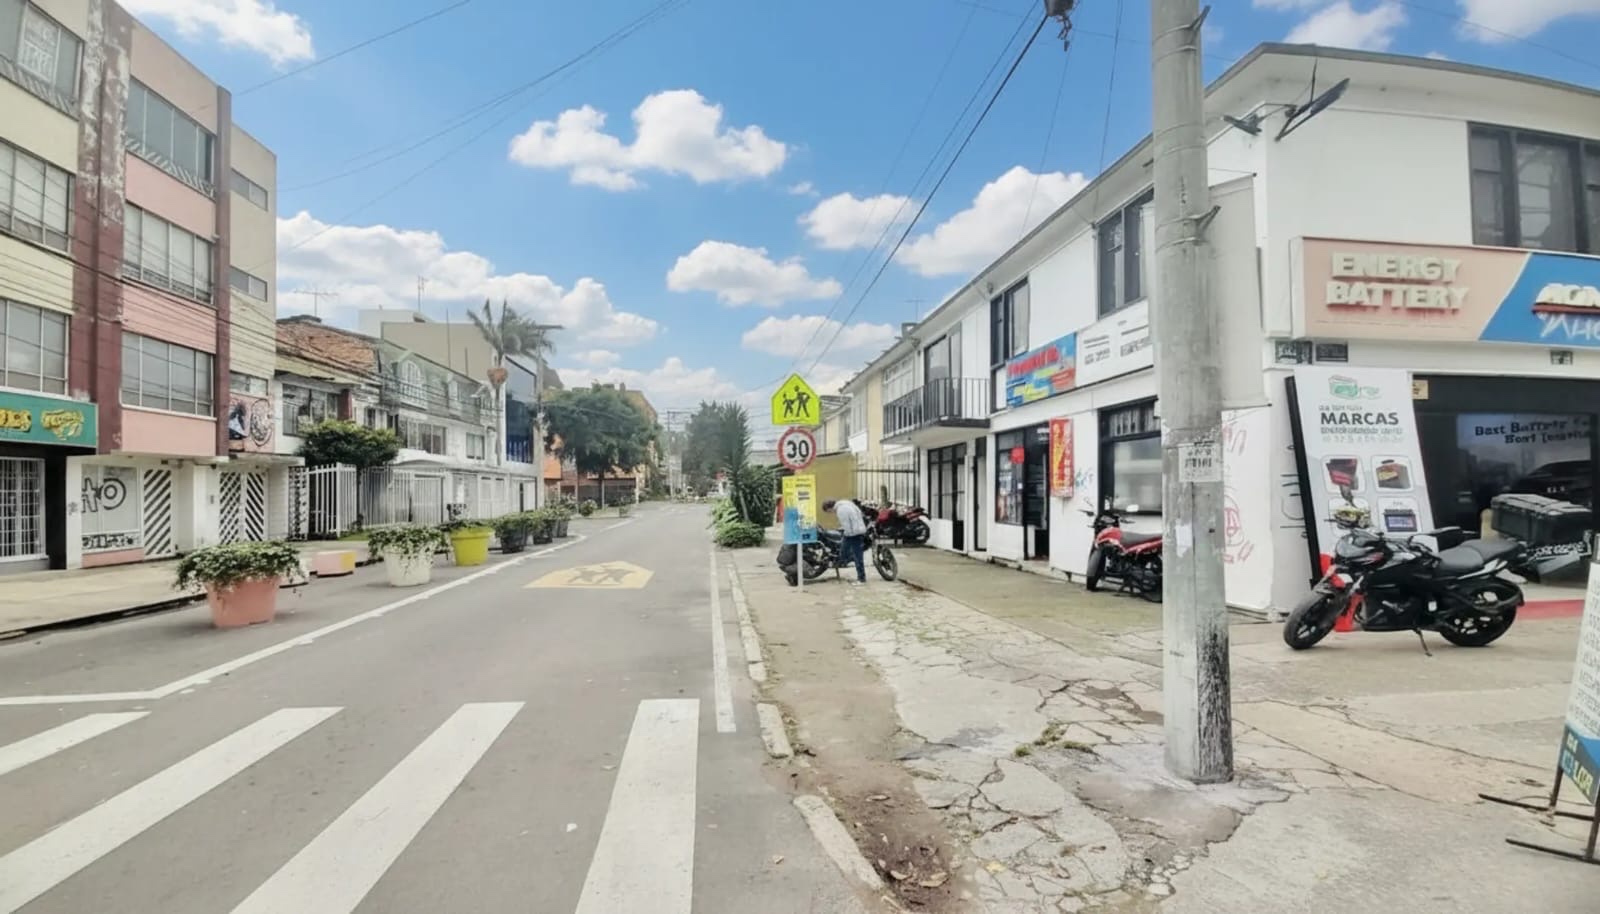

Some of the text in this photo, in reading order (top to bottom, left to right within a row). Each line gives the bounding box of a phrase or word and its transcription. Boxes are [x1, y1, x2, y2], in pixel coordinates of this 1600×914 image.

[1331, 252, 1462, 282] ENERGY
[1326, 281, 1469, 311] BATTERY
[1321, 412, 1399, 426] MARCAS
[787, 440, 809, 459] 30
